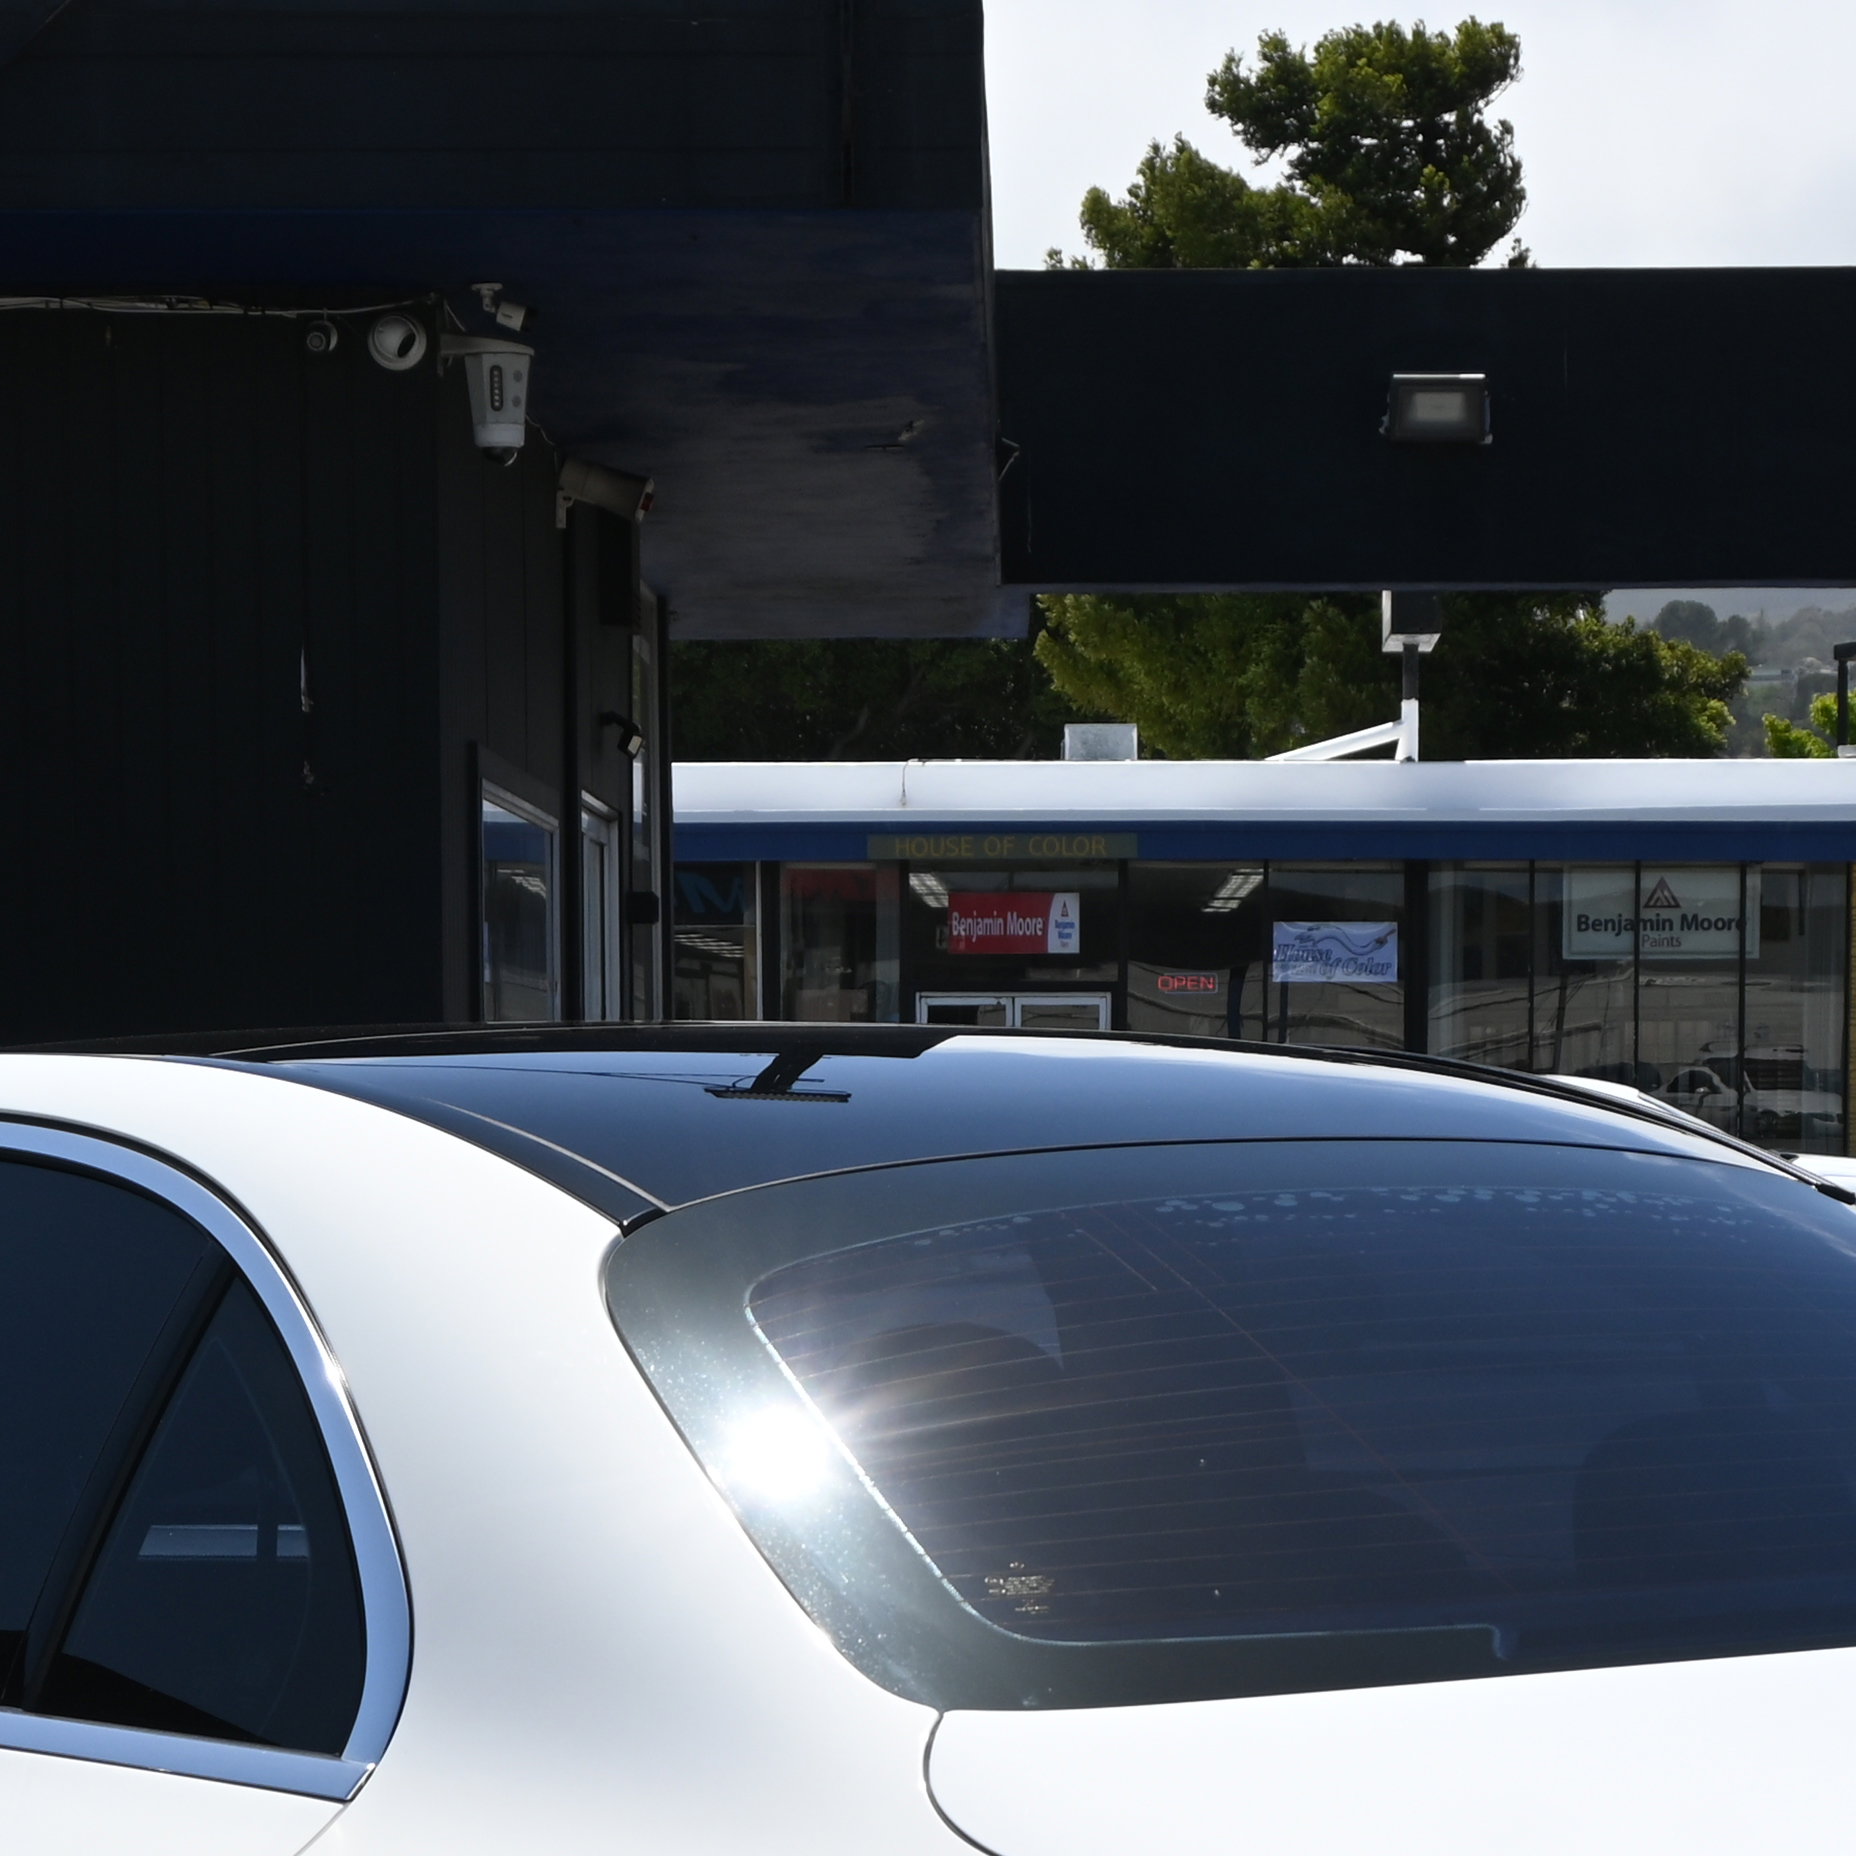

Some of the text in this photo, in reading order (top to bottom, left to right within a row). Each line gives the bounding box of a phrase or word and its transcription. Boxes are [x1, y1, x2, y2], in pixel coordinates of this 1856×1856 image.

[895, 836, 1107, 857] HOUSE OF COLOR
[952, 910, 1043, 943] Benjamin Moore
[1577, 913, 1674, 937] Benjamin
[1641, 934, 1682, 947] Paints
[1157, 975, 1216, 991] OPEN
